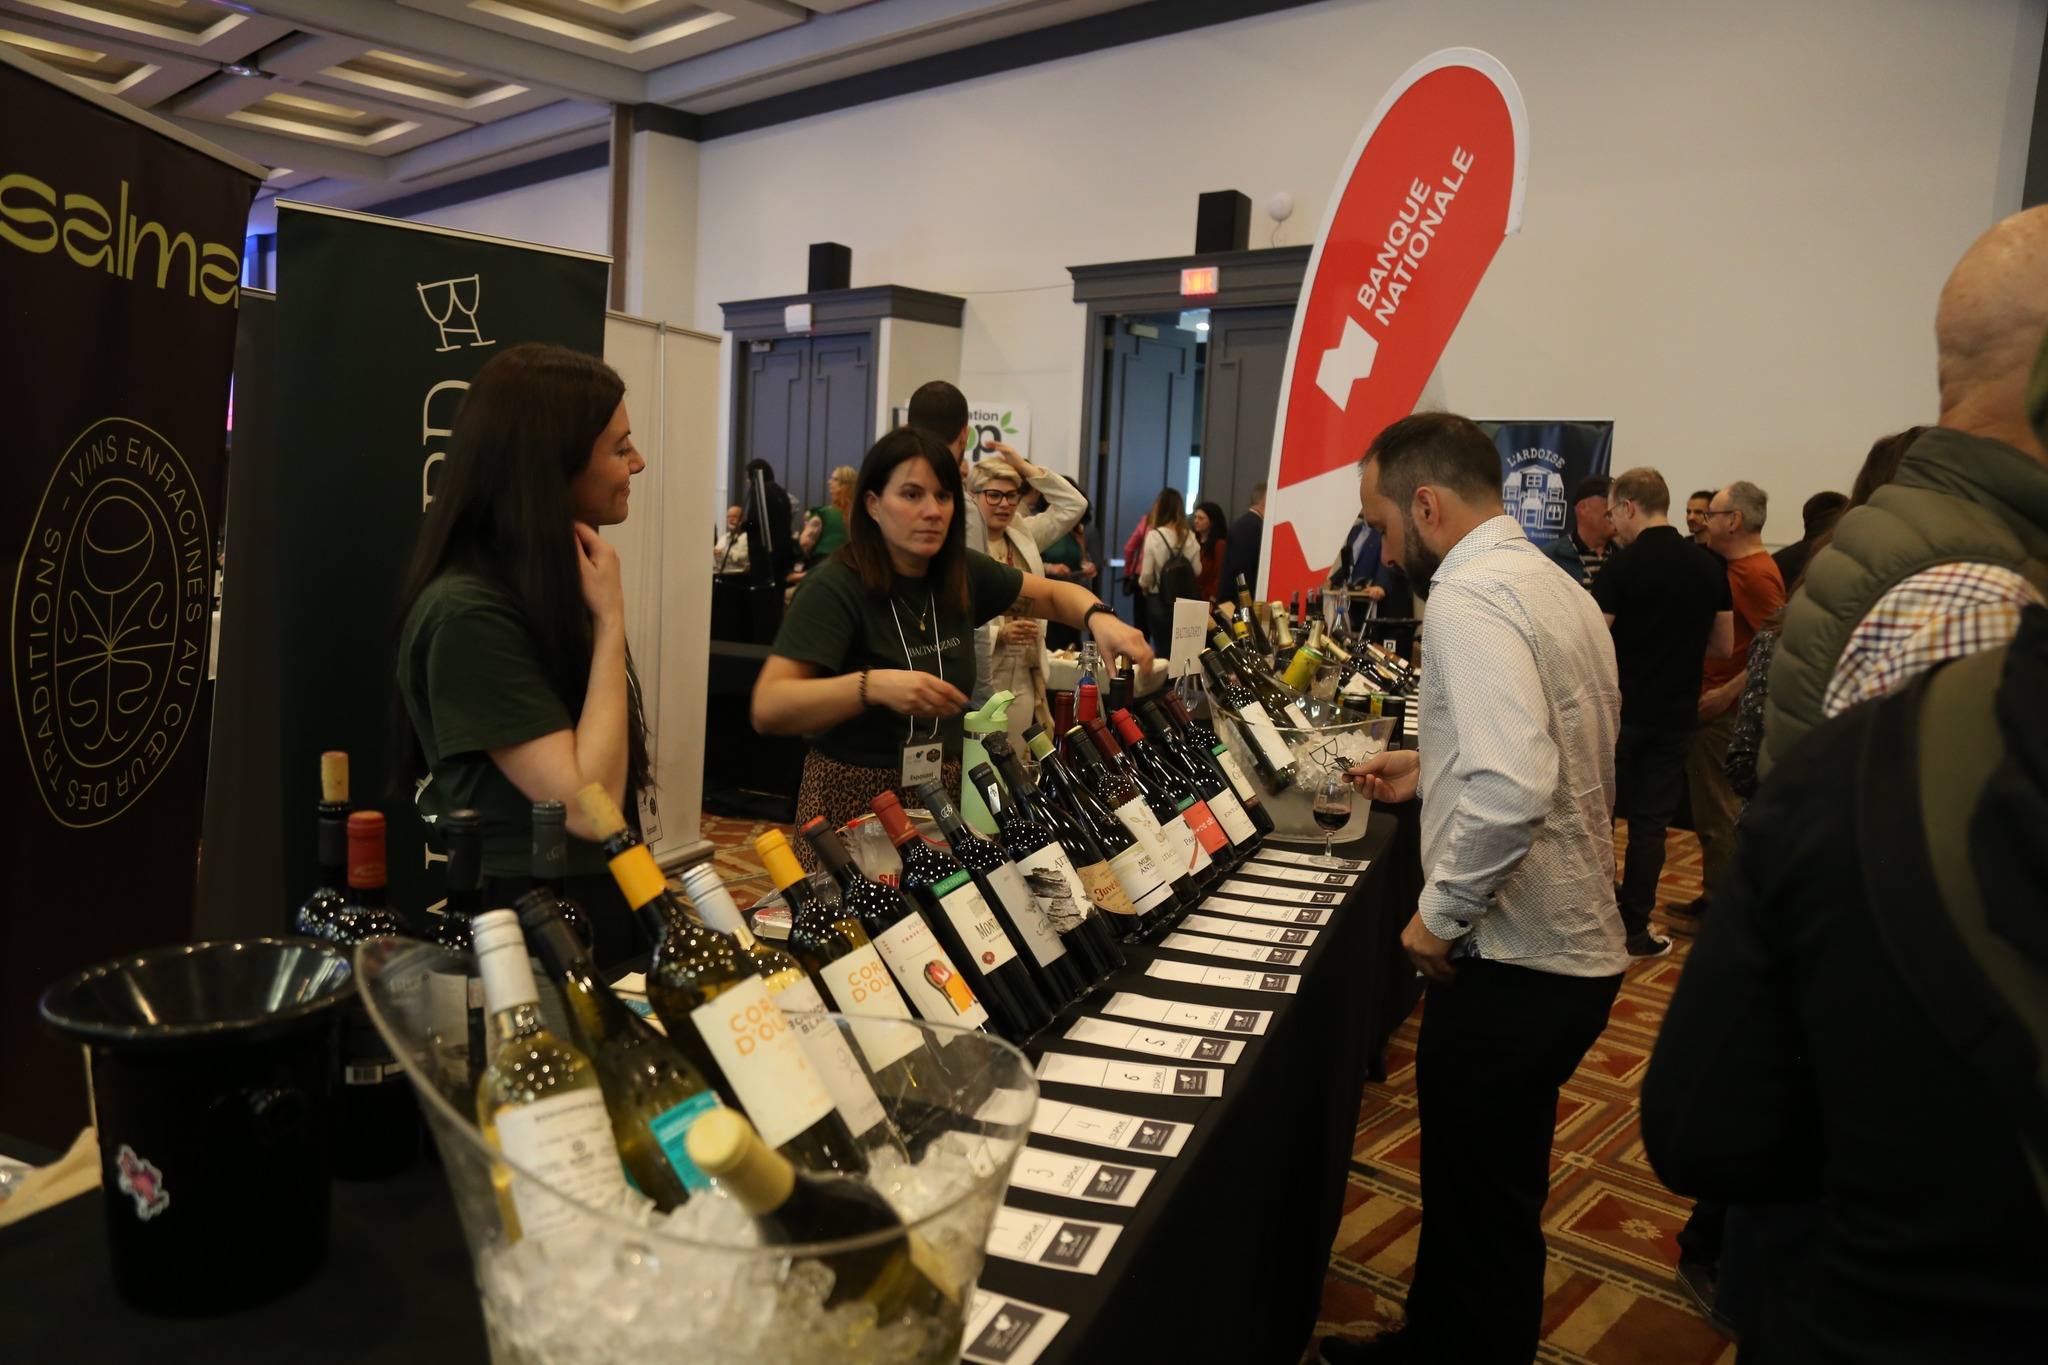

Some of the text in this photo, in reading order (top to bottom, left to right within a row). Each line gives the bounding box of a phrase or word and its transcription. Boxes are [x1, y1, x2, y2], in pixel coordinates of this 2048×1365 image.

[0, 173, 239, 309] salma
[1357, 177, 1431, 310] BANQUE
[1375, 145, 1474, 326] NATIONALE
[70, 434, 117, 488] VINS
[1506, 447, 1566, 469] L'ARDOISE
[126, 437, 207, 622] ENRACINÉS
[30, 528, 63, 792] TRADITIONS
[177, 639, 198, 686] AU
[66, 779, 107, 810] DES
[1152, 1071, 1163, 1089] COUPONS
[1108, 1119, 1127, 1141] COUPONS
[1061, 1164, 1083, 1188] COUPONS
